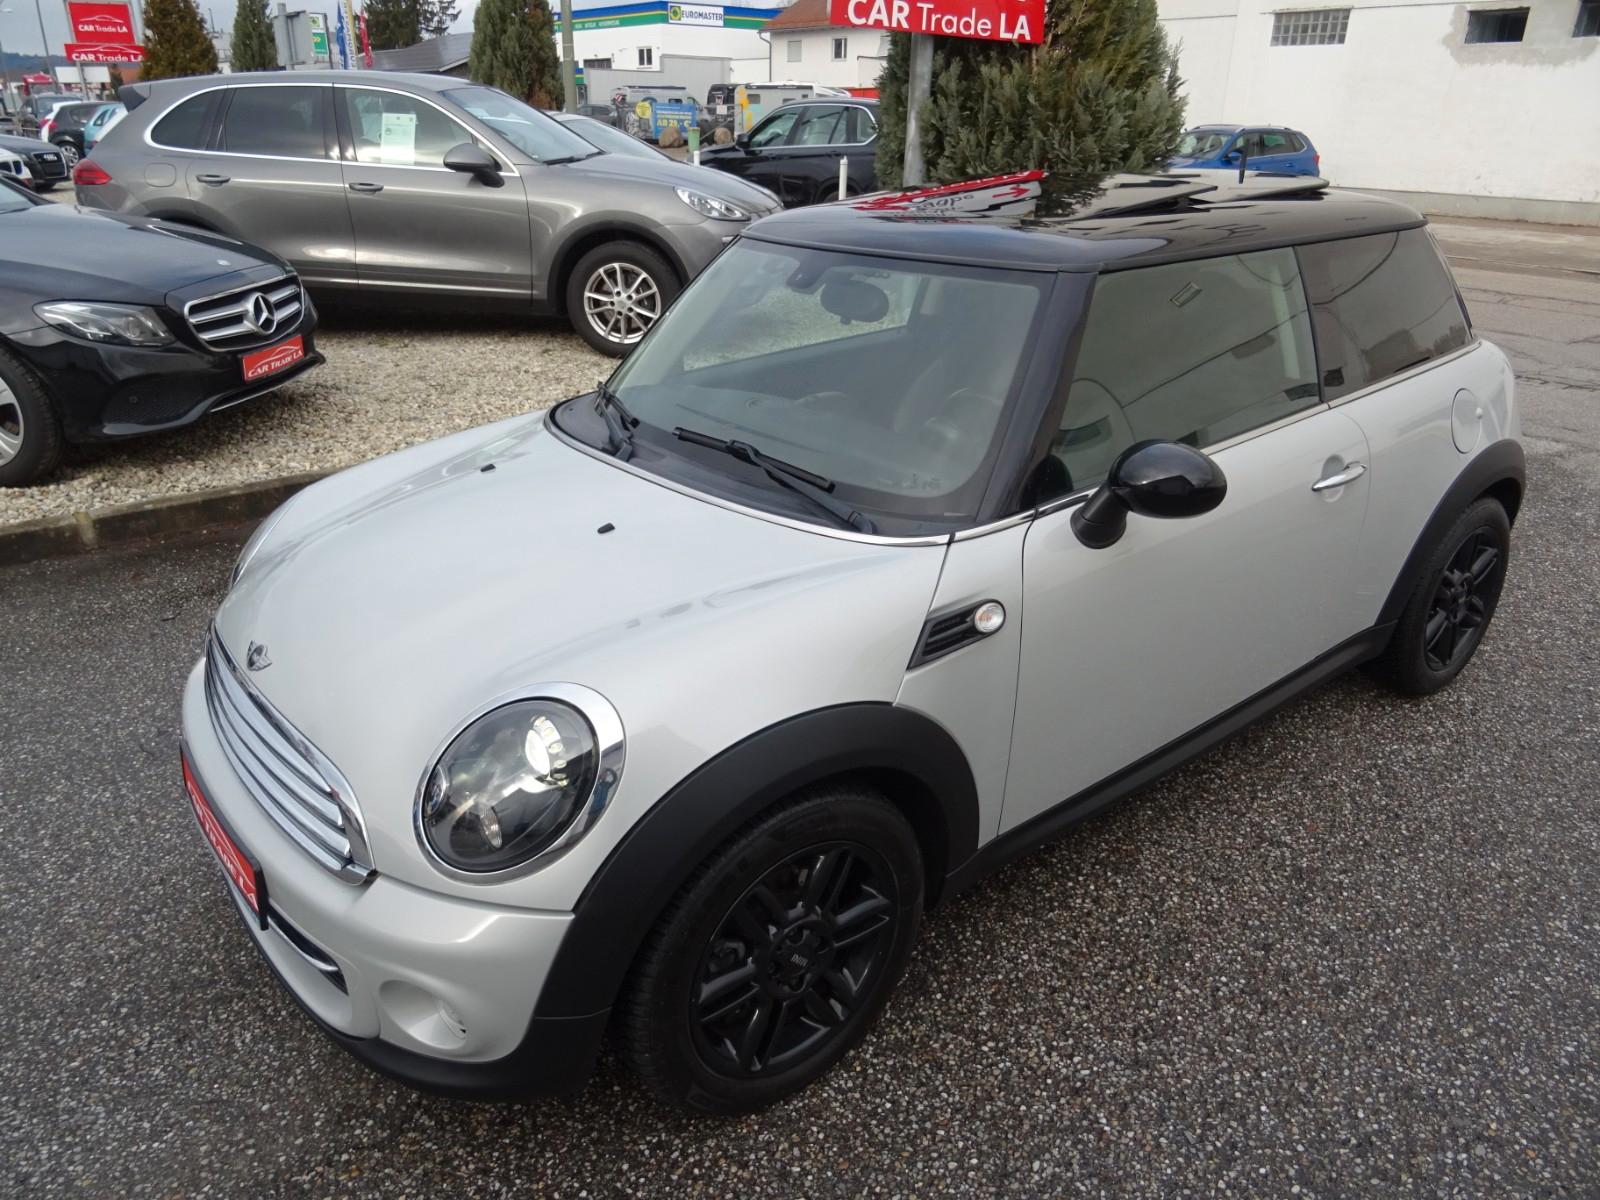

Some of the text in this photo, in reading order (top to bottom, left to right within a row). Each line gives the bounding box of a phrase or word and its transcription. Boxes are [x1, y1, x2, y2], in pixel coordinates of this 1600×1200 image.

[681, 10, 723, 21] EUROMASTER
[848, 0, 1031, 41] CAR Trade LA
[78, 24, 95, 32] CAR
[72, 53, 95, 61] CAR
[97, 53, 129, 62] Trade
[248, 350, 302, 377] CAR TRADE LA
